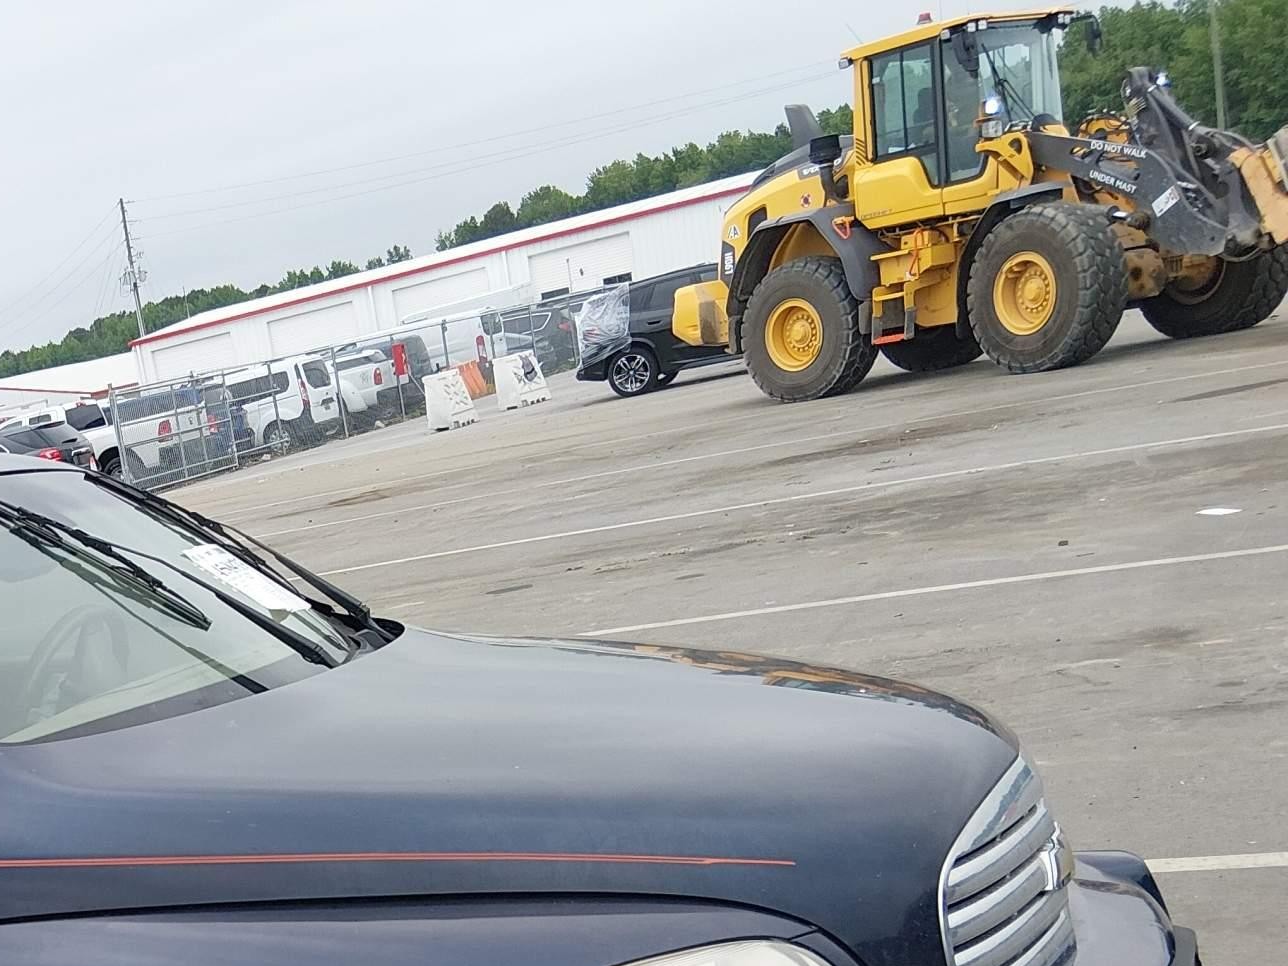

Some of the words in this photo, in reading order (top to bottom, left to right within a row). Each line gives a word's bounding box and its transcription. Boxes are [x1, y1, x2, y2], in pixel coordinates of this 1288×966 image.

[1091, 141, 1103, 150] DO
[1104, 144, 1122, 154] NOT
[1123, 147, 1146, 158] WALK
[1089, 170, 1115, 184] UNDER
[1115, 180, 1137, 194] MAST
